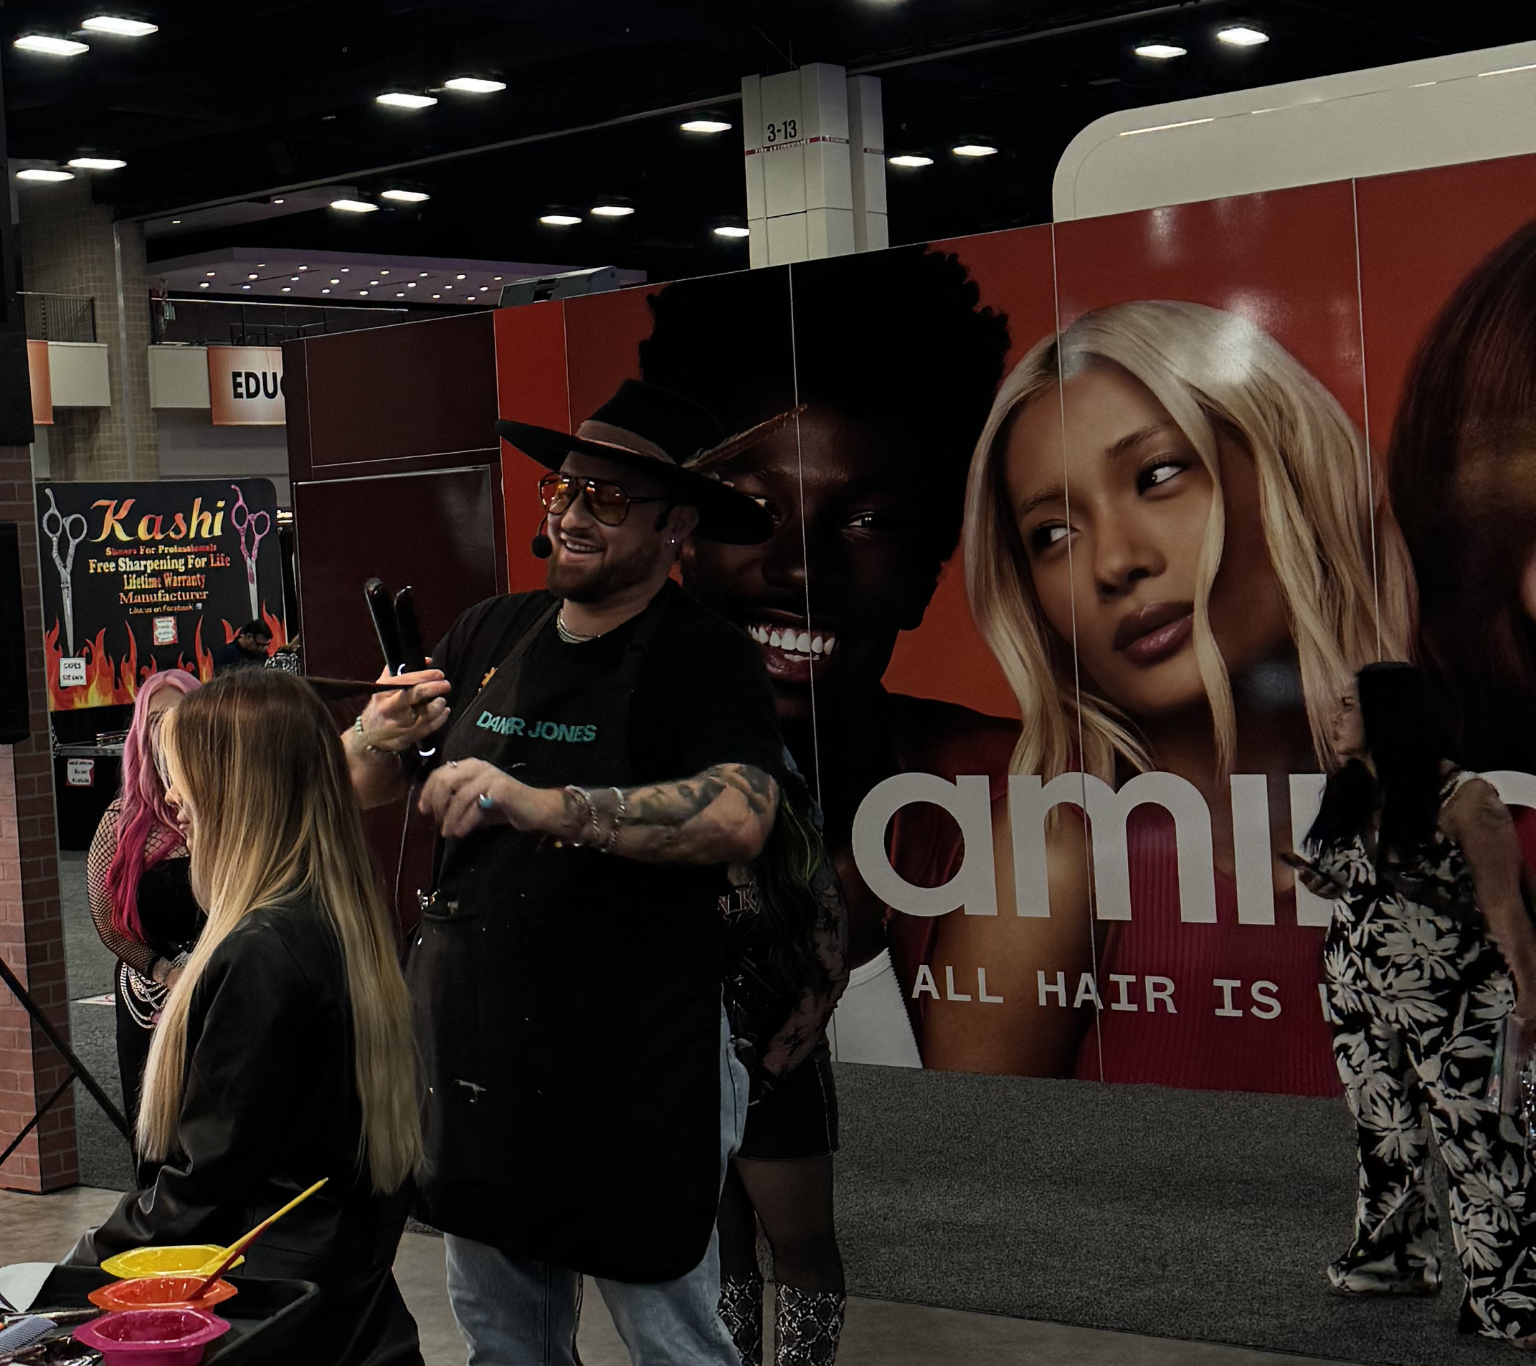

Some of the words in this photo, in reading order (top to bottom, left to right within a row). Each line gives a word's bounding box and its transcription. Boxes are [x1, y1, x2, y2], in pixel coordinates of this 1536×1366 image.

[767, 119, 797, 142] 3-13
[87, 497, 226, 542] Kashi
[139, 545, 156, 555] For
[88, 558, 116, 573] Free
[118, 555, 185, 573] Sharpening
[187, 555, 207, 568] For
[209, 553, 231, 567] Life
[123, 573, 162, 590] Lifetime
[164, 572, 205, 588] Warranty
[119, 590, 209, 604] Manufacturer
[476, 710, 526, 736] DANR
[528, 720, 598, 742] JONES
[851, 770, 1536, 927] ami
[912, 963, 1004, 1004] ALL
[1037, 968, 1178, 1014] HAIR
[1213, 977, 1282, 1020] IS
